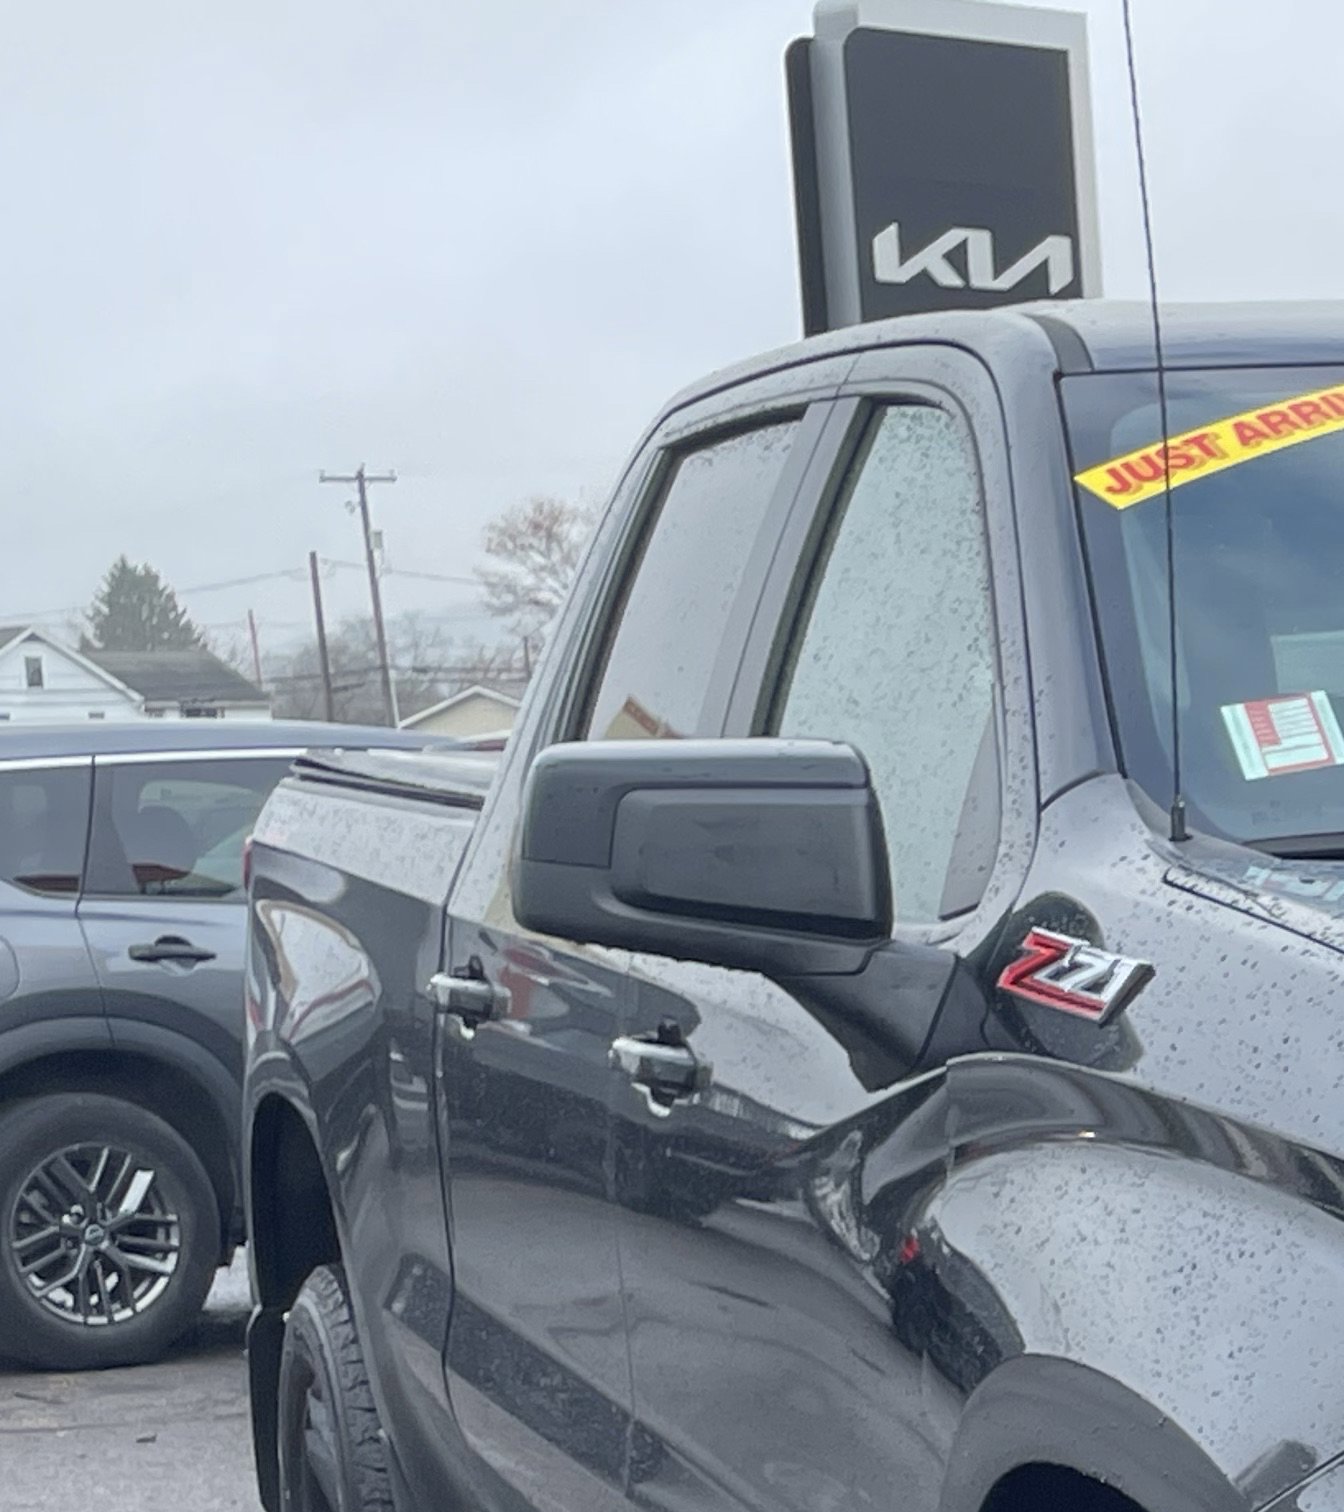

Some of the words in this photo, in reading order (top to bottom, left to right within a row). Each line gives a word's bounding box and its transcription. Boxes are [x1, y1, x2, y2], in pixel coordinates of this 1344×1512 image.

[873, 222, 1073, 295] KIA
[1105, 432, 1230, 496] JUST
[997, 926, 1155, 1024] Z71
